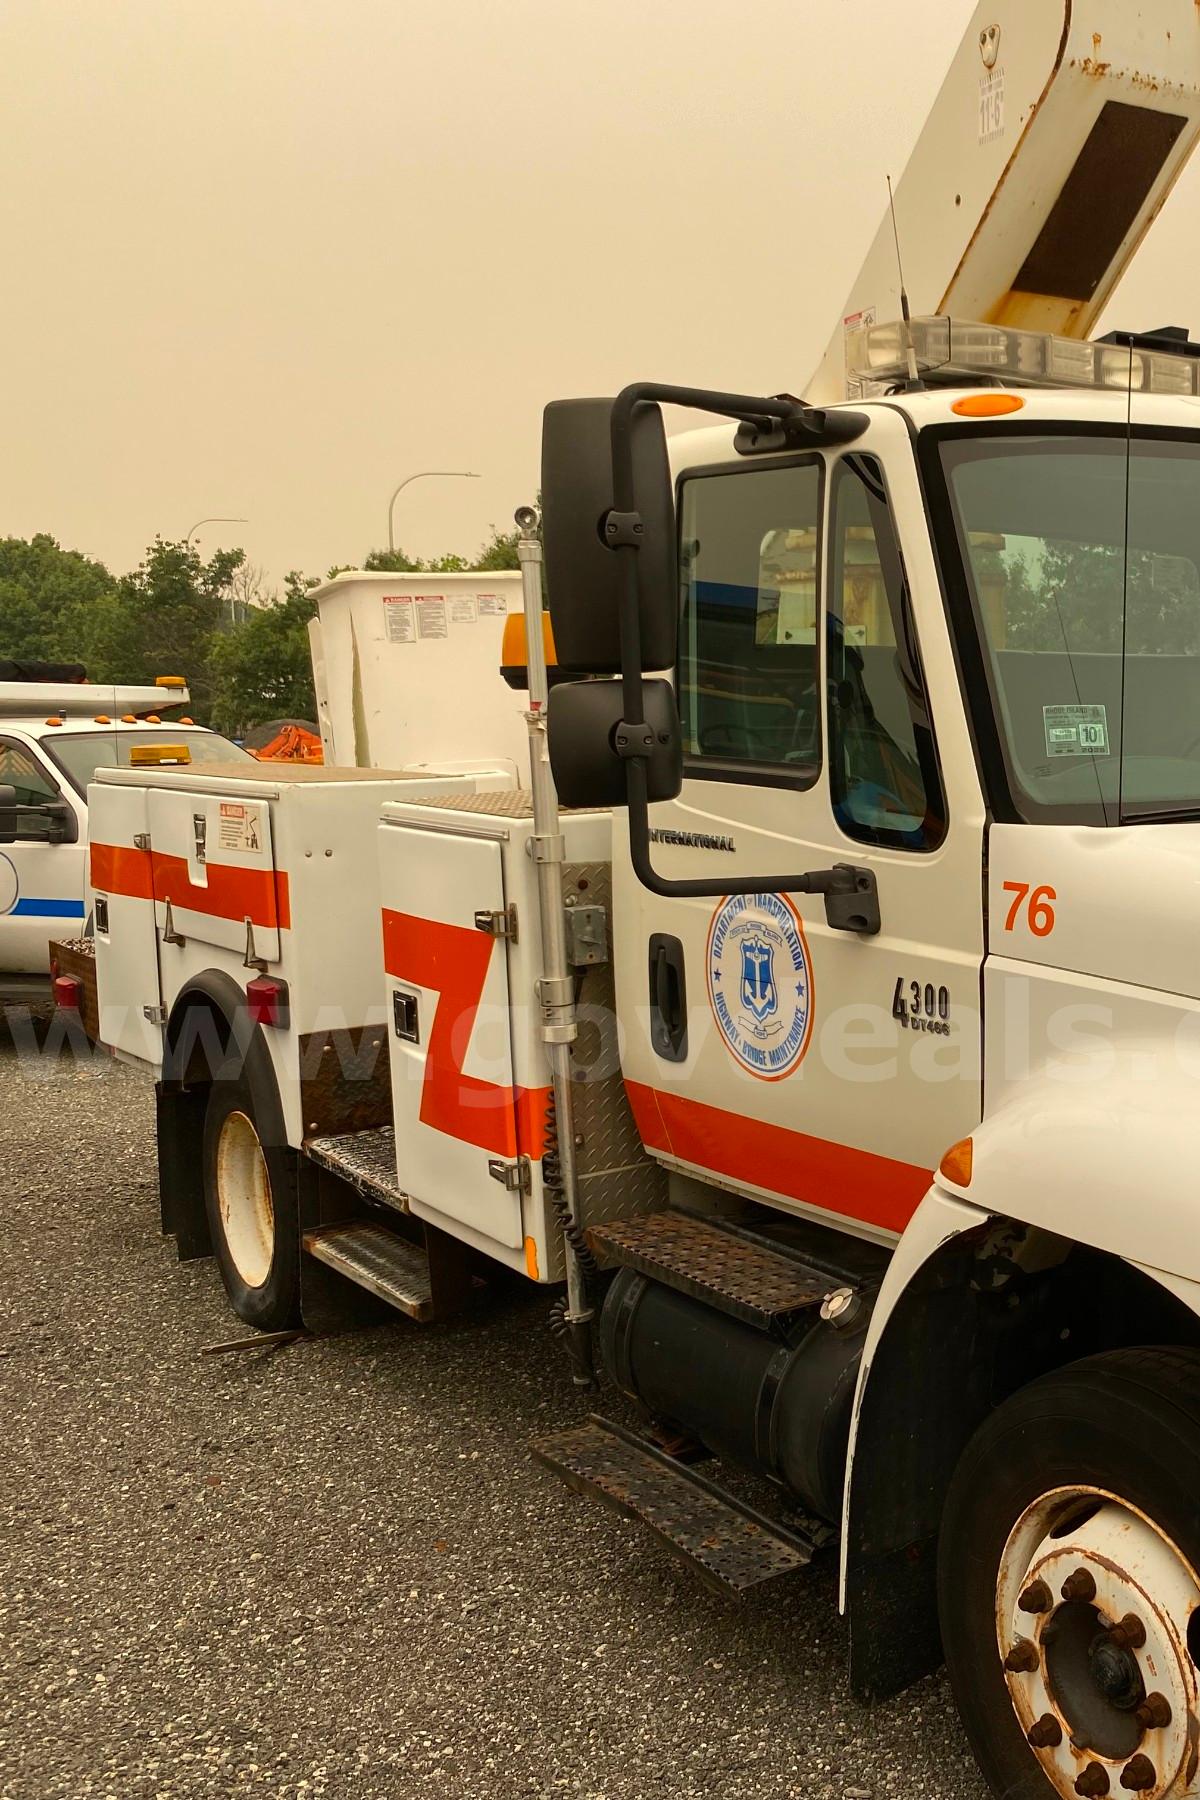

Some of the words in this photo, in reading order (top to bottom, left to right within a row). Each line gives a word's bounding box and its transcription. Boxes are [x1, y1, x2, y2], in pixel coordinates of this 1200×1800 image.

[1083, 727, 1098, 743] 10
[713, 895, 747, 959] DEPARTMENT
[754, 894, 804, 971] TRANSPORTATION
[1003, 881, 1057, 937] 76
[715, 991, 741, 1044] HIGHWAY
[742, 1039, 767, 1067] BRIDGE
[768, 1004, 806, 1067] MAINTENANCE
[892, 976, 950, 1029] 4300
[910, 1016, 950, 1037] DT466
